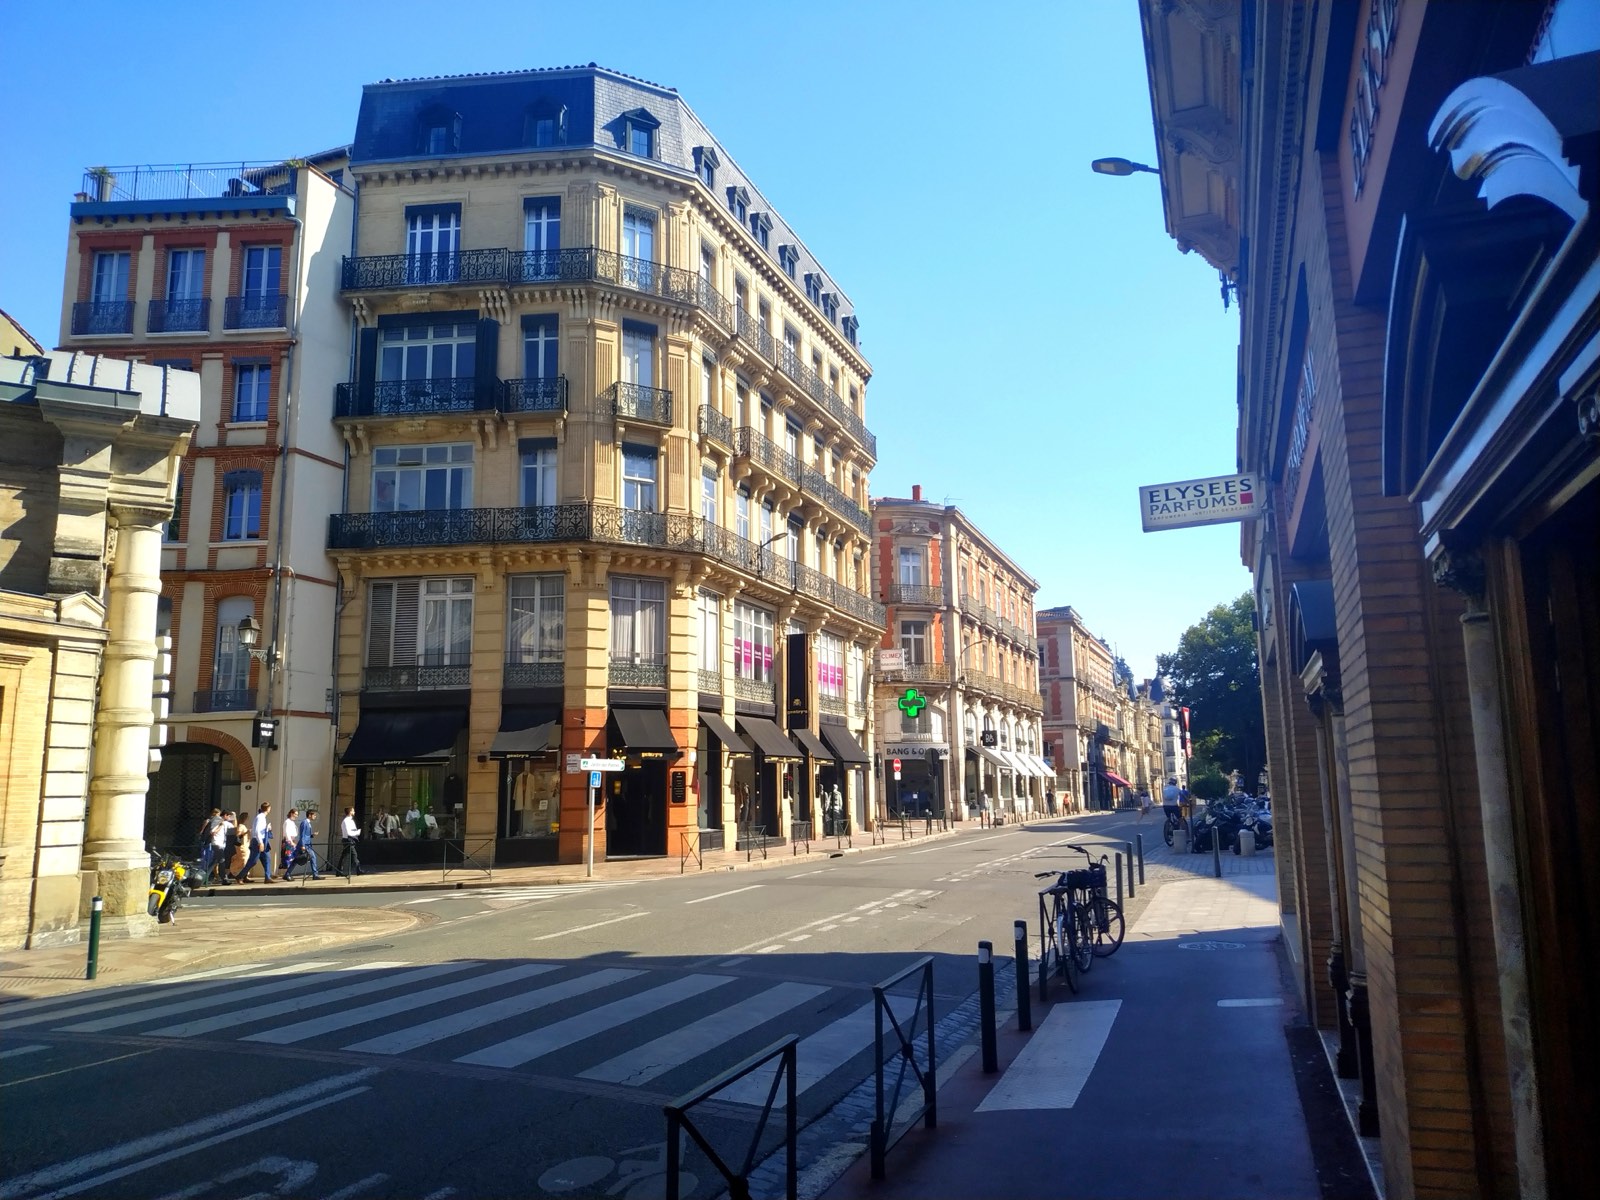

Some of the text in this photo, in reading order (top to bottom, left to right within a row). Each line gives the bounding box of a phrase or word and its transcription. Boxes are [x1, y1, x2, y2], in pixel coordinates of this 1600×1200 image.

[1148, 478, 1253, 504] ELYSEES
[1149, 494, 1238, 516] PARFUMS
[886, 747, 910, 756] BANG
